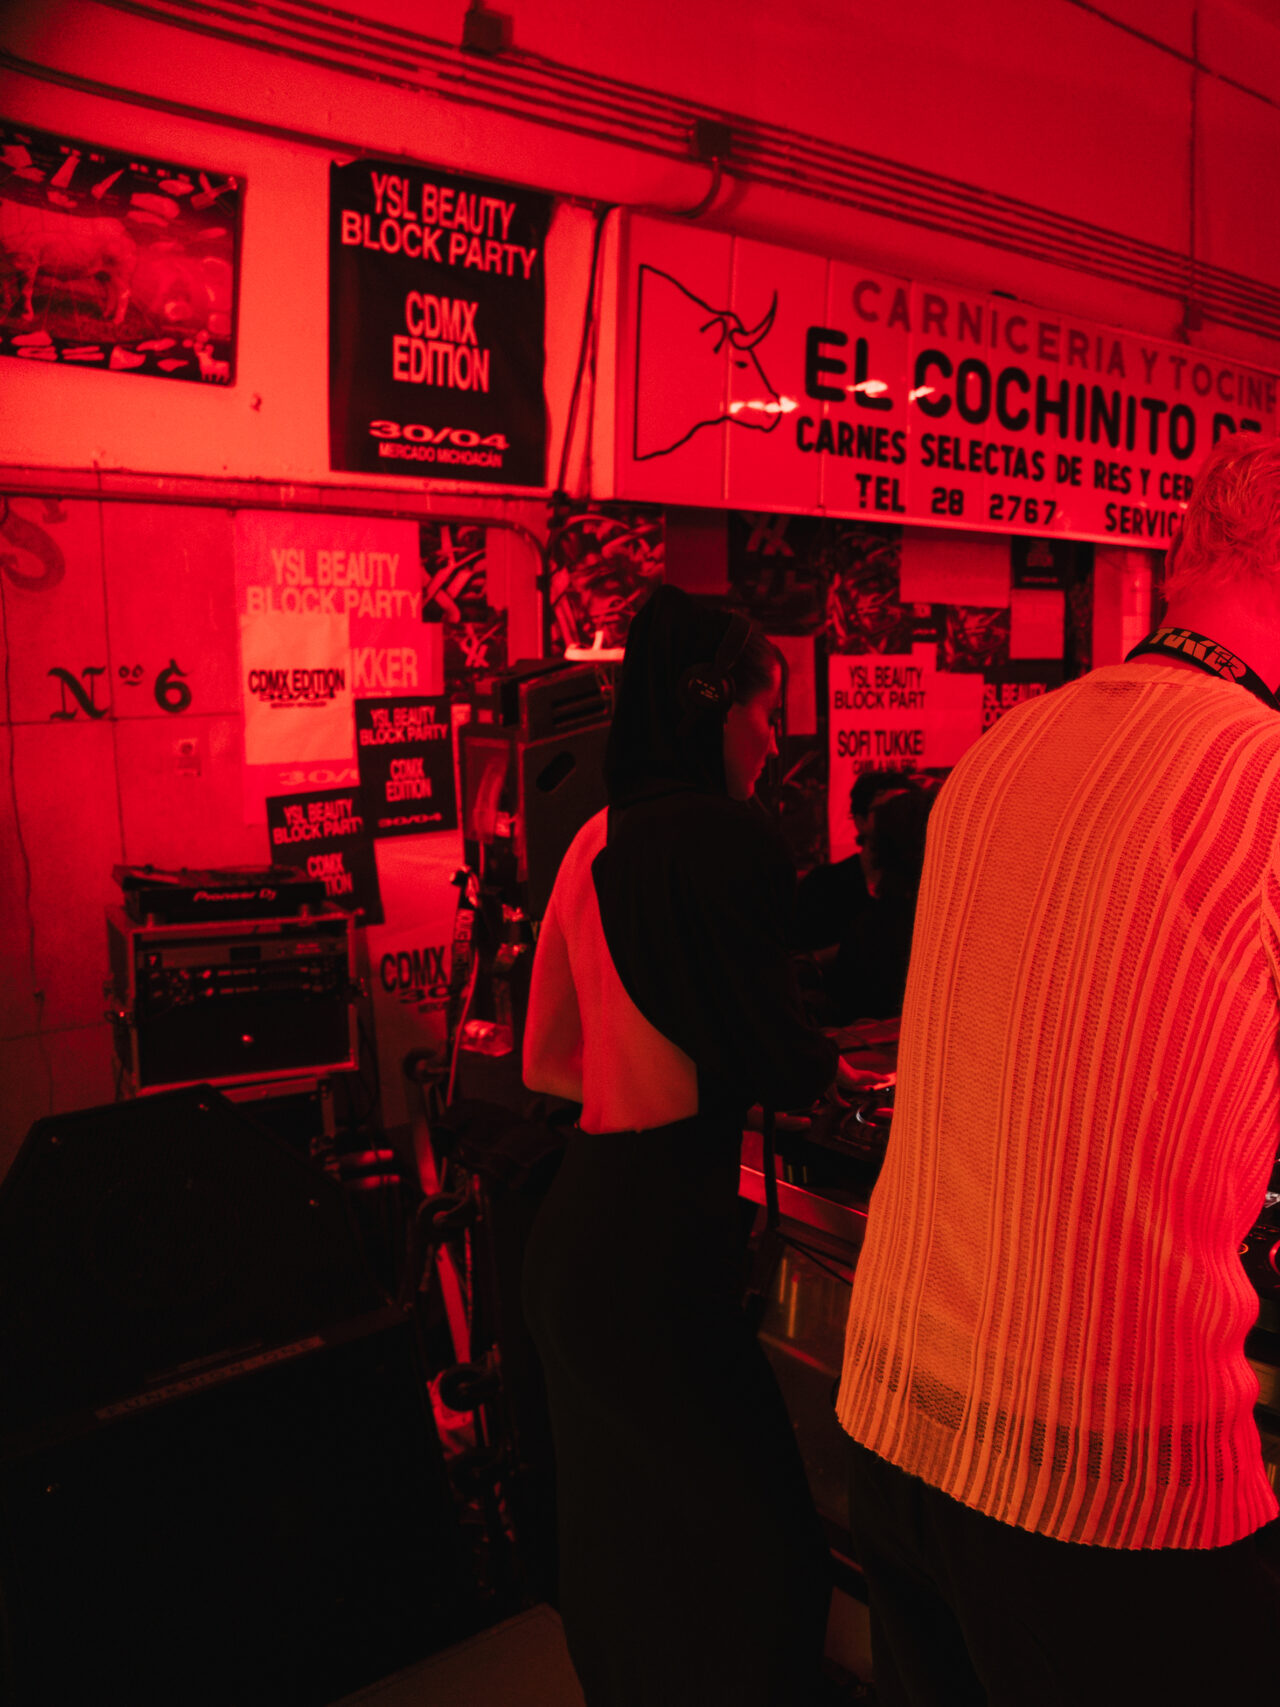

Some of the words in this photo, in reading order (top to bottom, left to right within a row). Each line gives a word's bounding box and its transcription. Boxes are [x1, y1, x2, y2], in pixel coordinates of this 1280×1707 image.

[371, 171, 417, 222] YSL
[421, 183, 516, 240] BEAUTY
[341, 210, 442, 262] BLOCK
[449, 232, 536, 279] PARTY
[404, 290, 479, 346] CDMX
[852, 279, 1126, 378] CARNICERIA
[1138, 350, 1158, 384] Y
[392, 334, 490, 393] EDITION
[805, 325, 894, 412] EL
[913, 348, 1196, 461] COCHINITO
[368, 419, 510, 450] 30/04
[378, 441, 436, 462] MERCADO
[796, 416, 907, 465] CARNES
[920, 432, 1046, 482] SELECTAS
[1055, 453, 1083, 487] DE
[1093, 458, 1132, 495] RES
[1139, 467, 1151, 497] Y
[1159, 473, 1194, 501] CER
[855, 473, 906, 513] TEL
[931, 487, 965, 516] 28
[989, 493, 1058, 525] 2767
[271, 548, 314, 587] YSL
[316, 550, 399, 588] BEAUTY
[246, 585, 337, 615] BLOCK
[344, 588, 421, 619] PARTY
[248, 669, 290, 694] CDMX
[293, 668, 346, 691] EDITION
[350, 646, 418, 689] KKER
[850, 666, 871, 688] YSL
[875, 666, 924, 689] BEAUTY
[154, 658, 196, 714] 6
[834, 690, 885, 709] BLOCK
[889, 690, 926, 709] PART
[370, 708, 393, 728] YSL
[393, 705, 436, 726] BEAUTY
[360, 727, 406, 746] BLOCK
[407, 723, 448, 742] PARTY
[838, 730, 870, 757] SOFI
[875, 730, 924, 756] TUKKE
[279, 768, 358, 787] 30/
[390, 757, 425, 780] CDMX
[385, 777, 432, 803] EDITION
[283, 804, 308, 826] YSL
[307, 799, 353, 822] BEAUTY
[273, 822, 322, 845] BLOCK
[307, 851, 345, 878] CDMX
[321, 872, 353, 896] TION
[381, 945, 449, 993] CDMX
